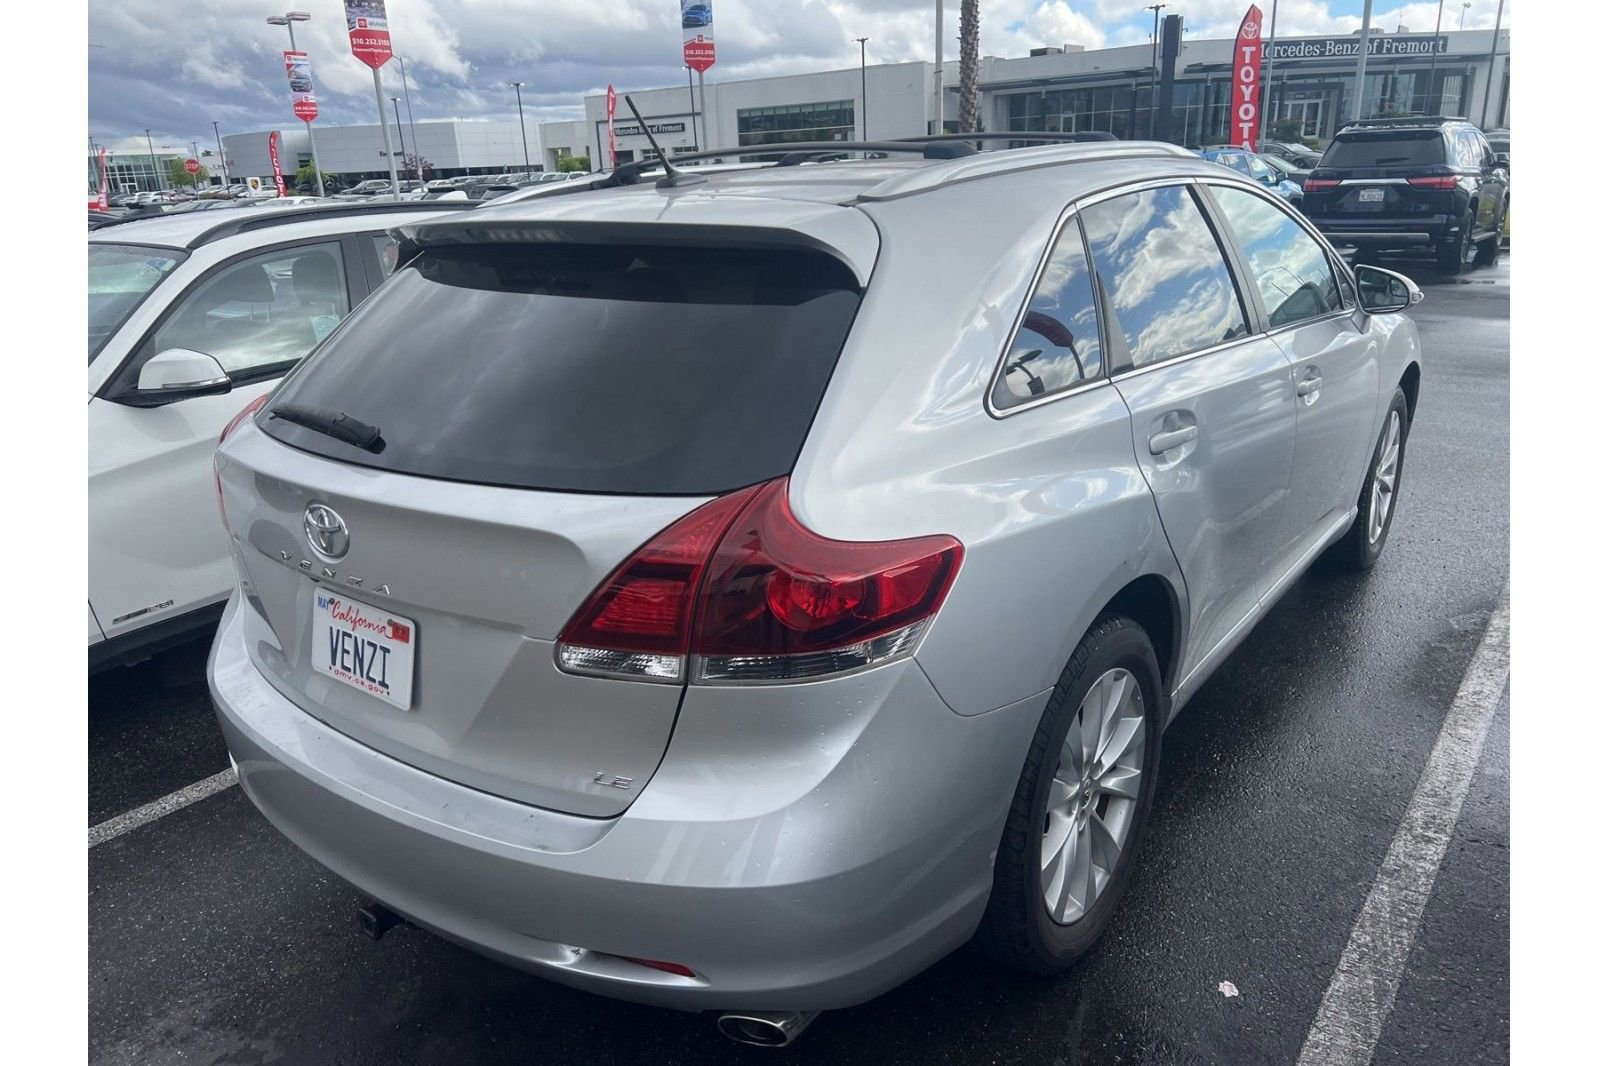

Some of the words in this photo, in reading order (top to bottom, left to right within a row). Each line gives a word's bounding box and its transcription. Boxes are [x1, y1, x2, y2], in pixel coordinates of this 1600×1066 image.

[1366, 39, 1378, 55] of
[185, 162, 199, 170] STOP
[281, 550, 391, 595] VENZA
[318, 596, 330, 610] MAY
[332, 600, 392, 639] California
[330, 626, 391, 690] VENZI
[334, 669, 384, 694] dmv.ca.gov
[593, 771, 633, 789] LE
